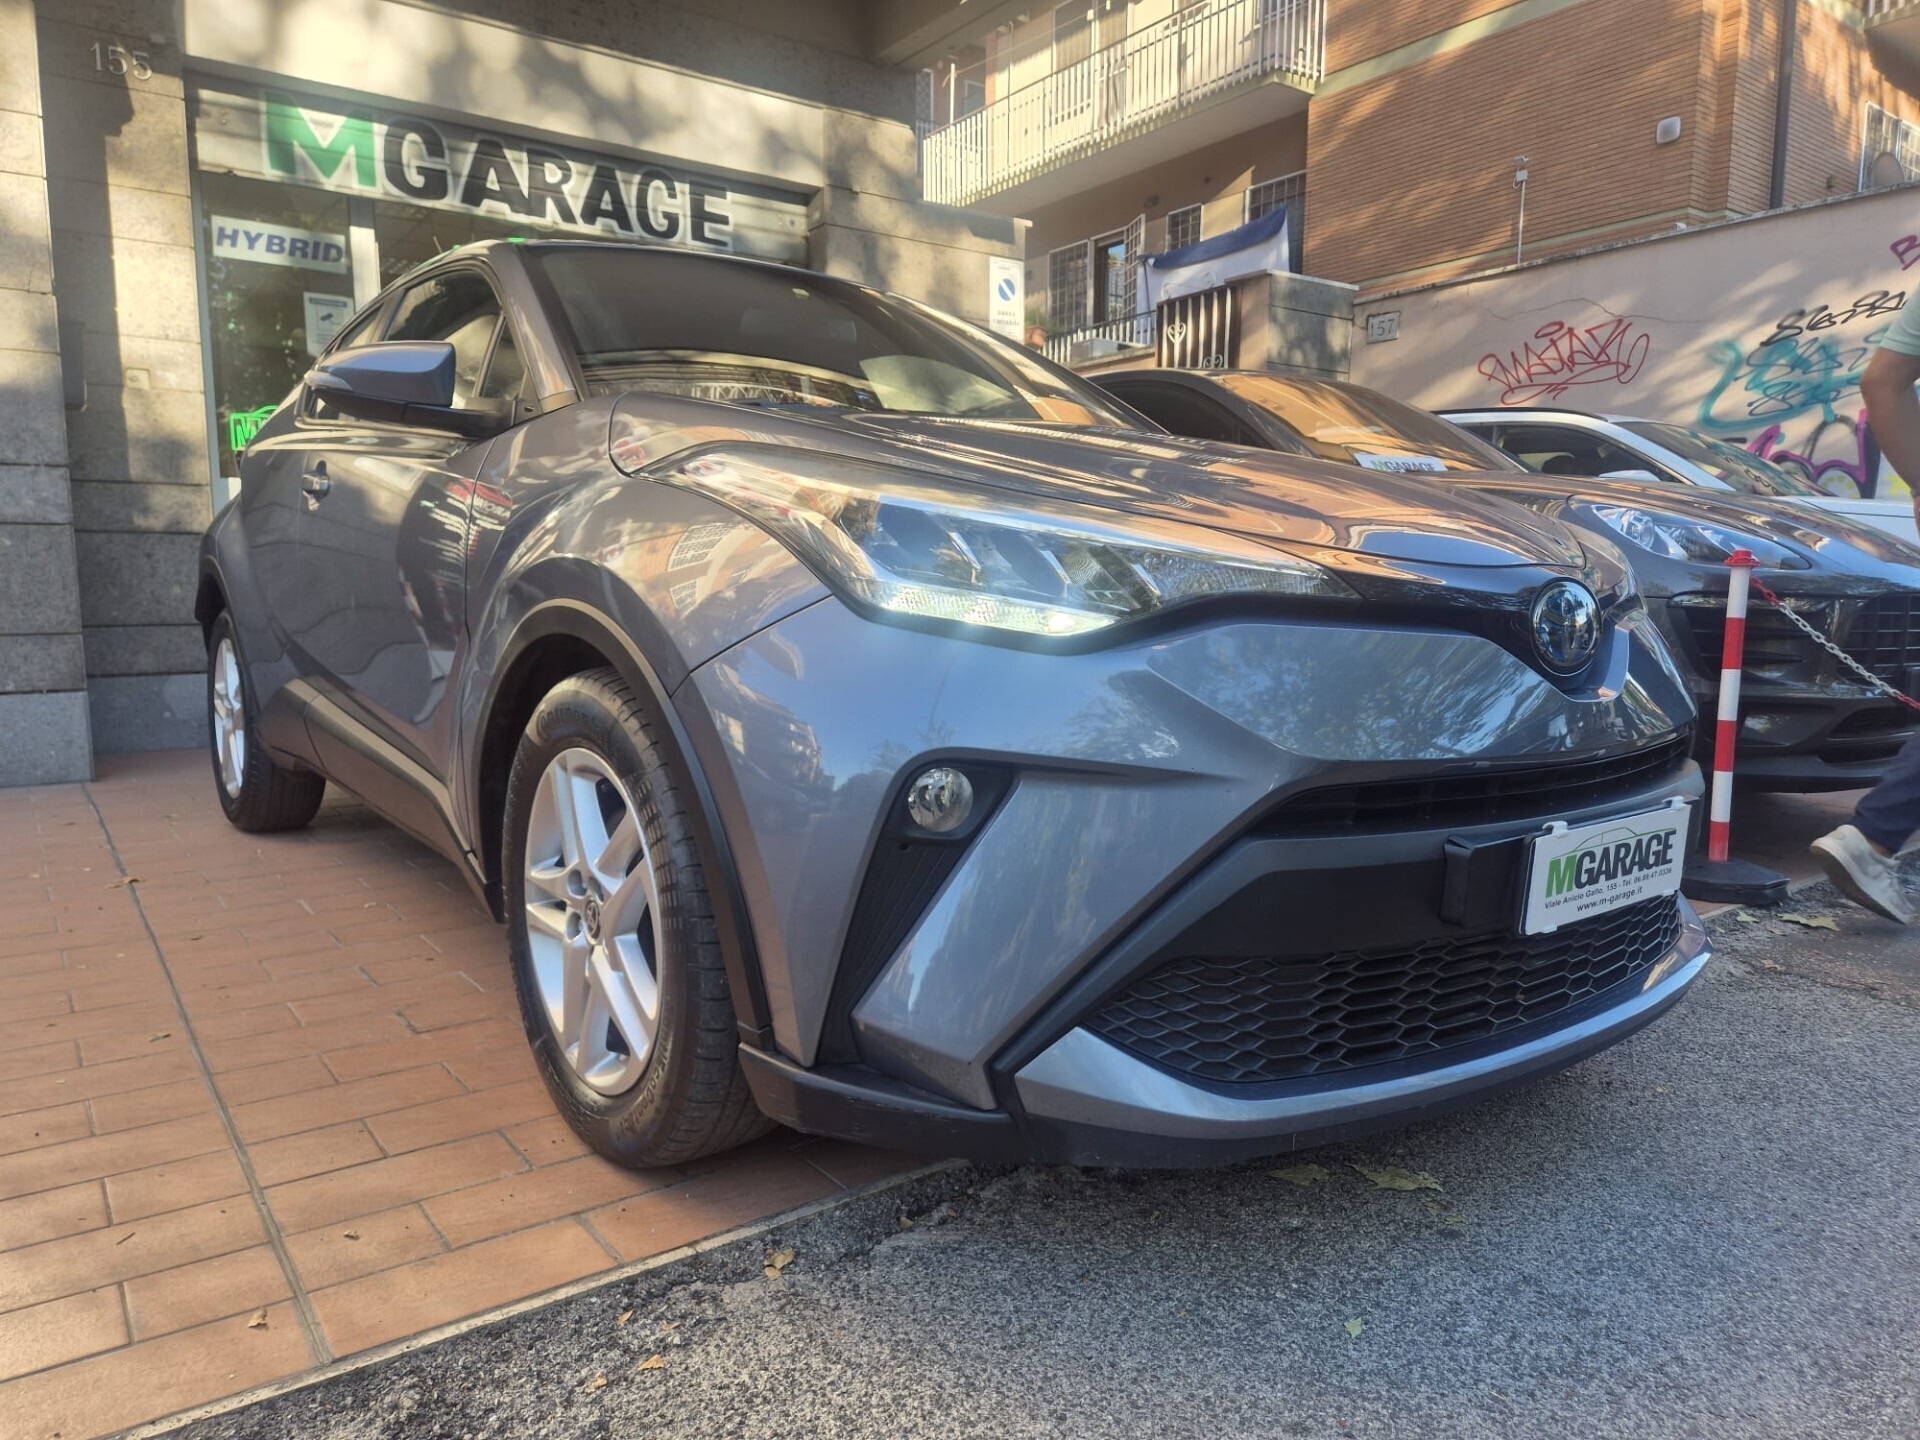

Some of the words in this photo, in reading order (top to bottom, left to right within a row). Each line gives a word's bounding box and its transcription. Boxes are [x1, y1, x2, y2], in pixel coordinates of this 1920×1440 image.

[89, 42, 152, 80] 155
[264, 93, 731, 248] MGARAGE
[216, 227, 343, 263] HYBRID
[1371, 318, 1395, 337] 157
[1545, 829, 1676, 898] MGARAGE
[1544, 900, 1561, 909] Viale
[1563, 893, 1584, 904] Anicio
[1606, 883, 1617, 891] 155
[1576, 886, 1643, 912] www.m-garage.it
